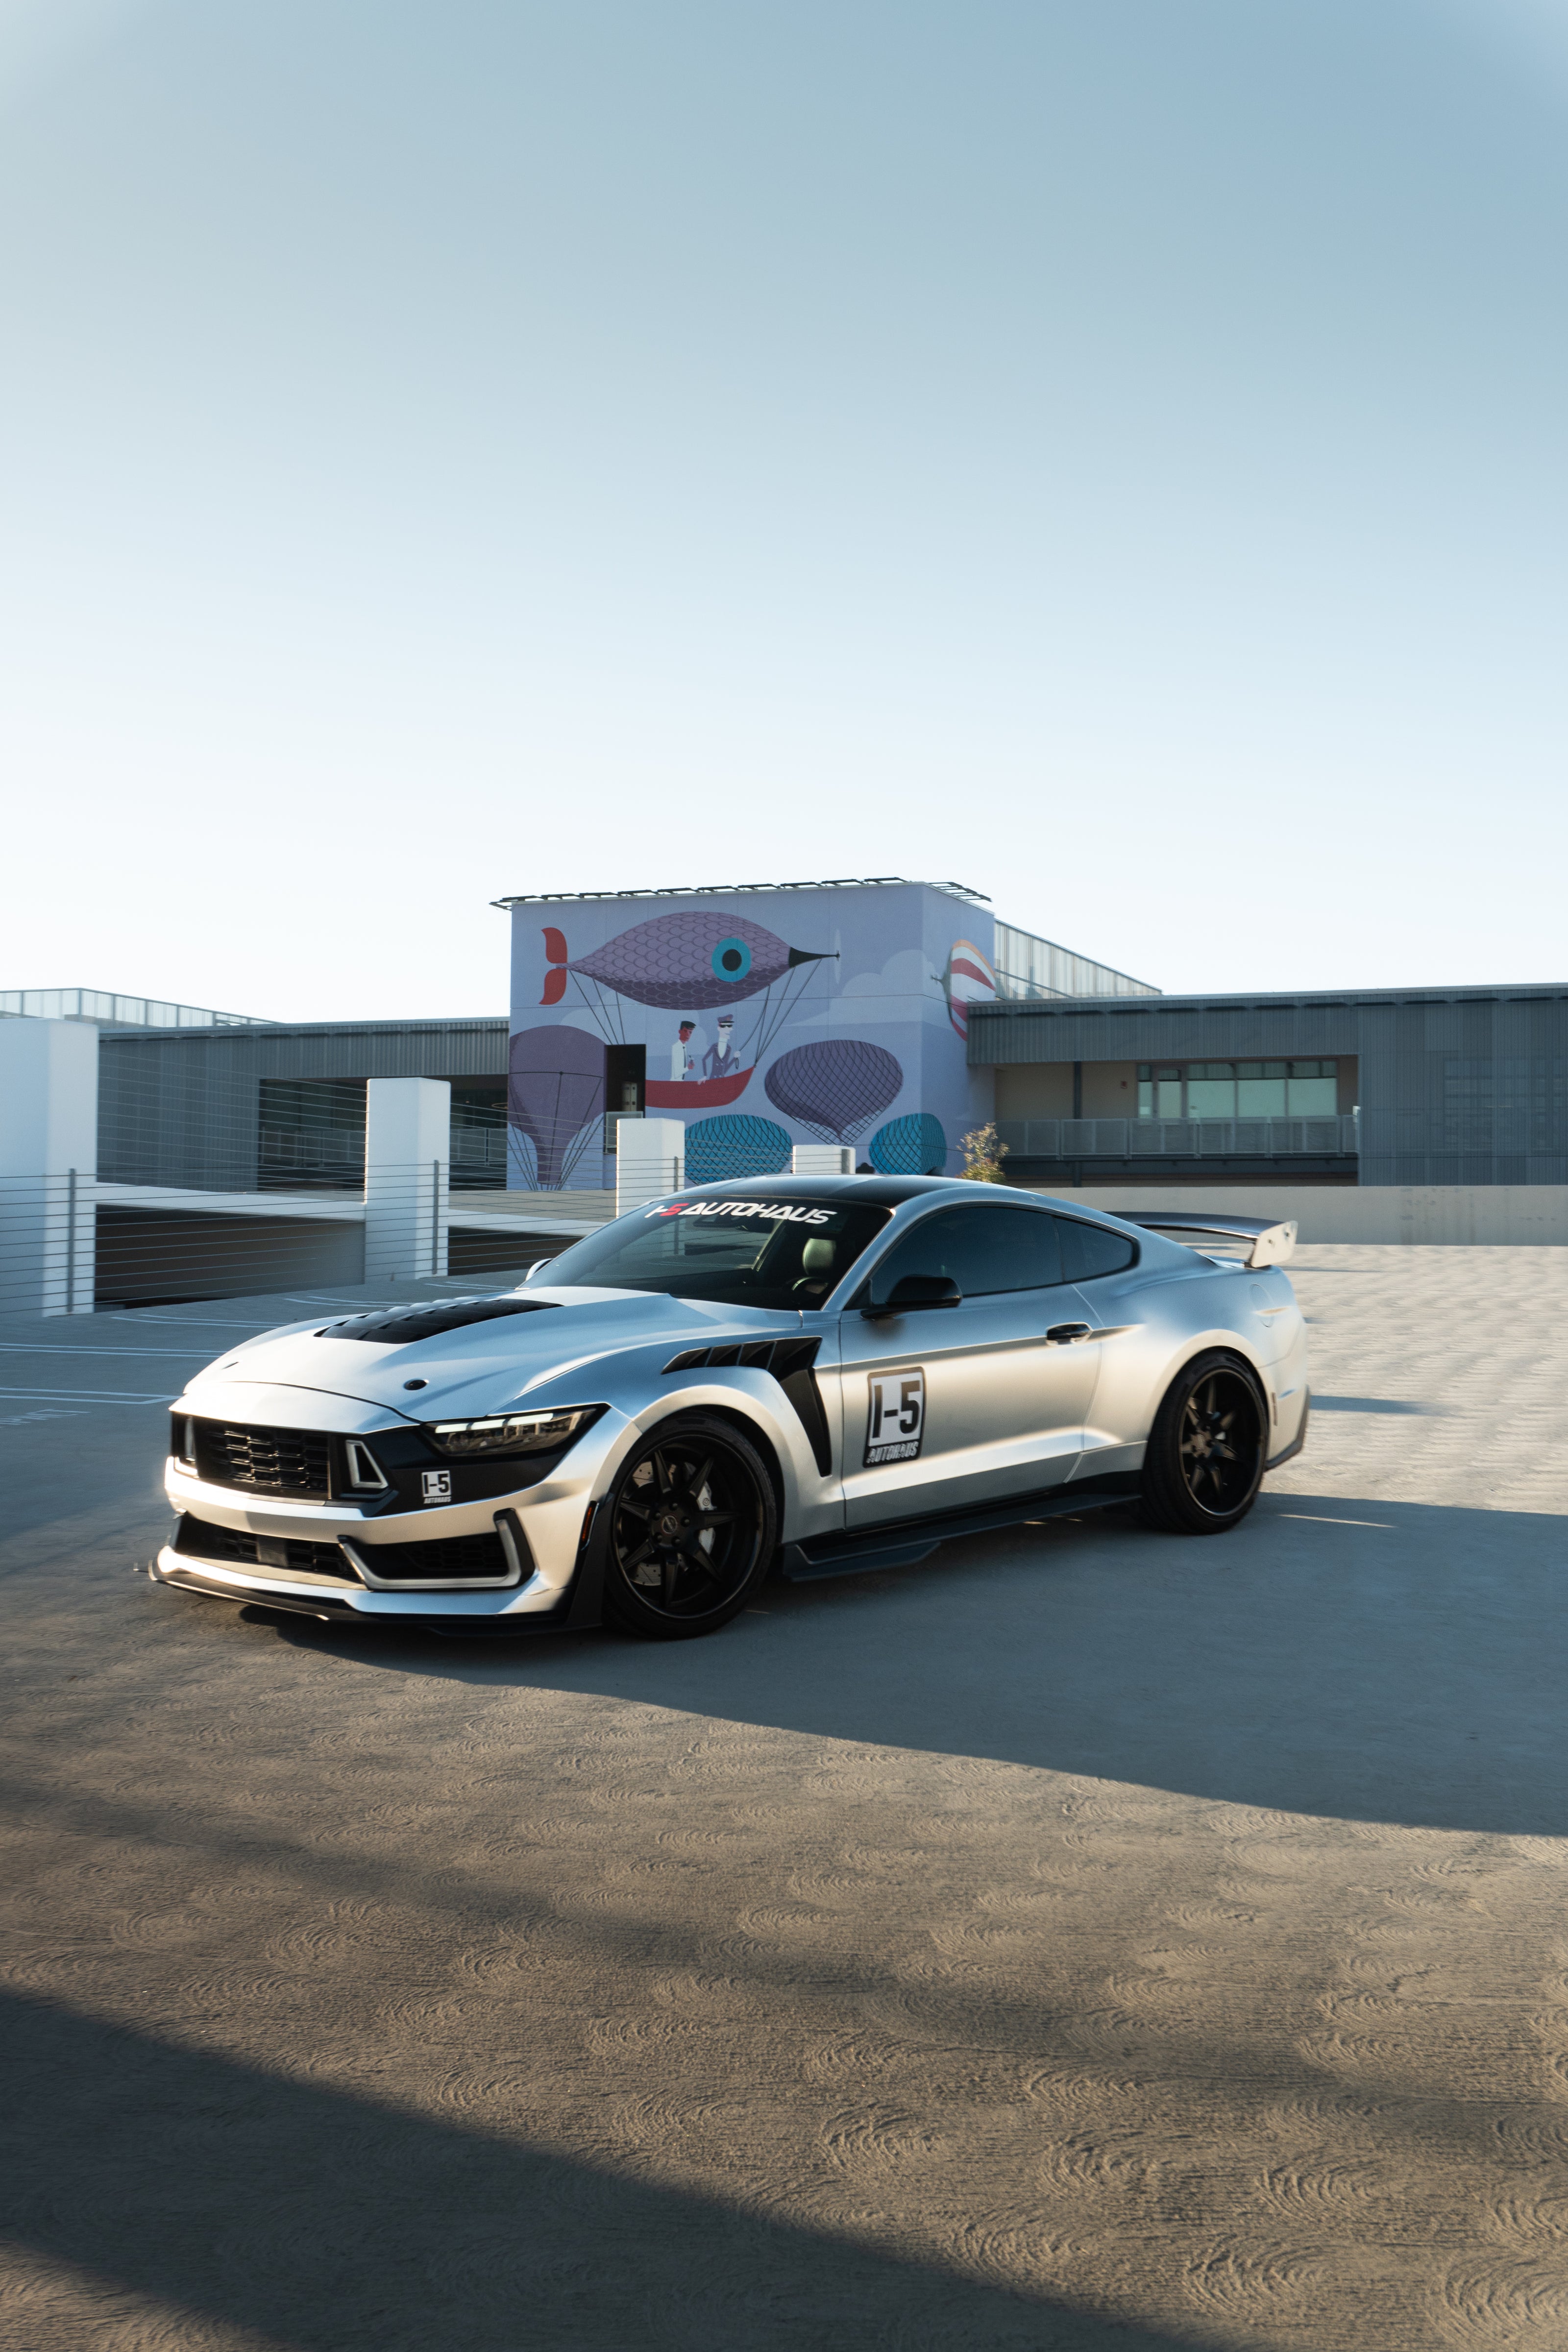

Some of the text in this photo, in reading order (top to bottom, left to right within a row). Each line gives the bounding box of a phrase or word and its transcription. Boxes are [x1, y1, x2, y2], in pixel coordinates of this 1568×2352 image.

[872, 1380, 921, 1439] I-5
[866, 1442, 919, 1463] AUTOHAUS
[423, 1473, 449, 1494] I-5
